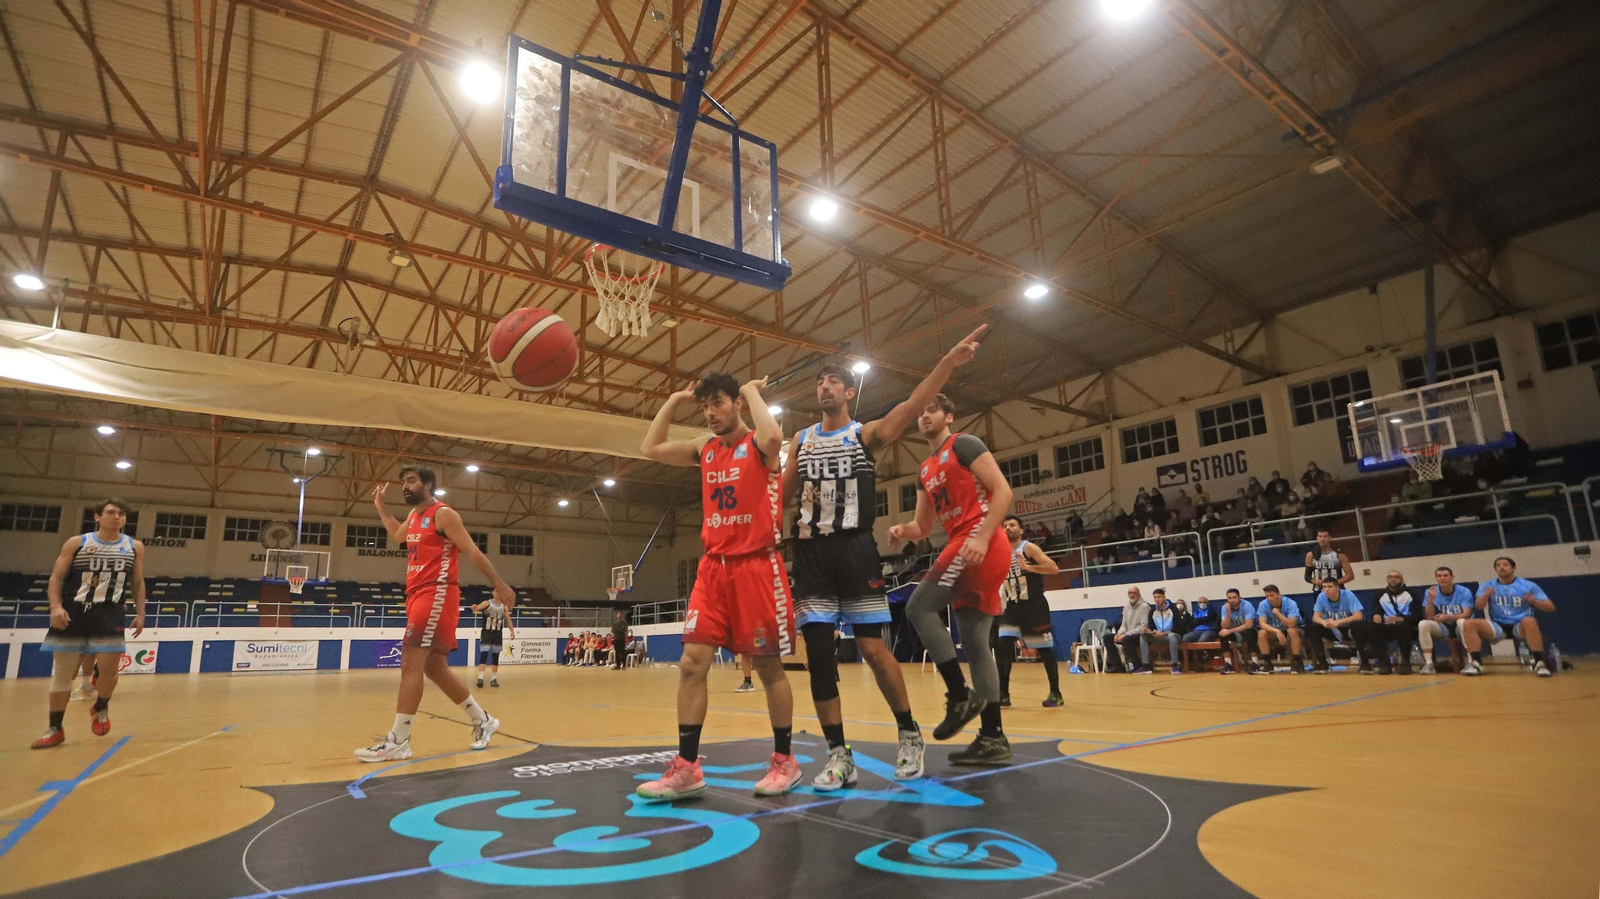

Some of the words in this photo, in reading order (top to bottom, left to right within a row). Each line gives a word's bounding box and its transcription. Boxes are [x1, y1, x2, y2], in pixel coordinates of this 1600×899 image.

[806, 456, 852, 480] ULB
[1190, 449, 1248, 483] STROG
[710, 485, 738, 510] 18
[1022, 483, 1075, 500] SUPERMERCADOS
[142, 538, 187, 548] UNION
[358, 548, 408, 558] BALONCE
[89, 558, 127, 571] ULB
[1494, 595, 1522, 607] ULB
[246, 643, 307, 654] Sumitecni
